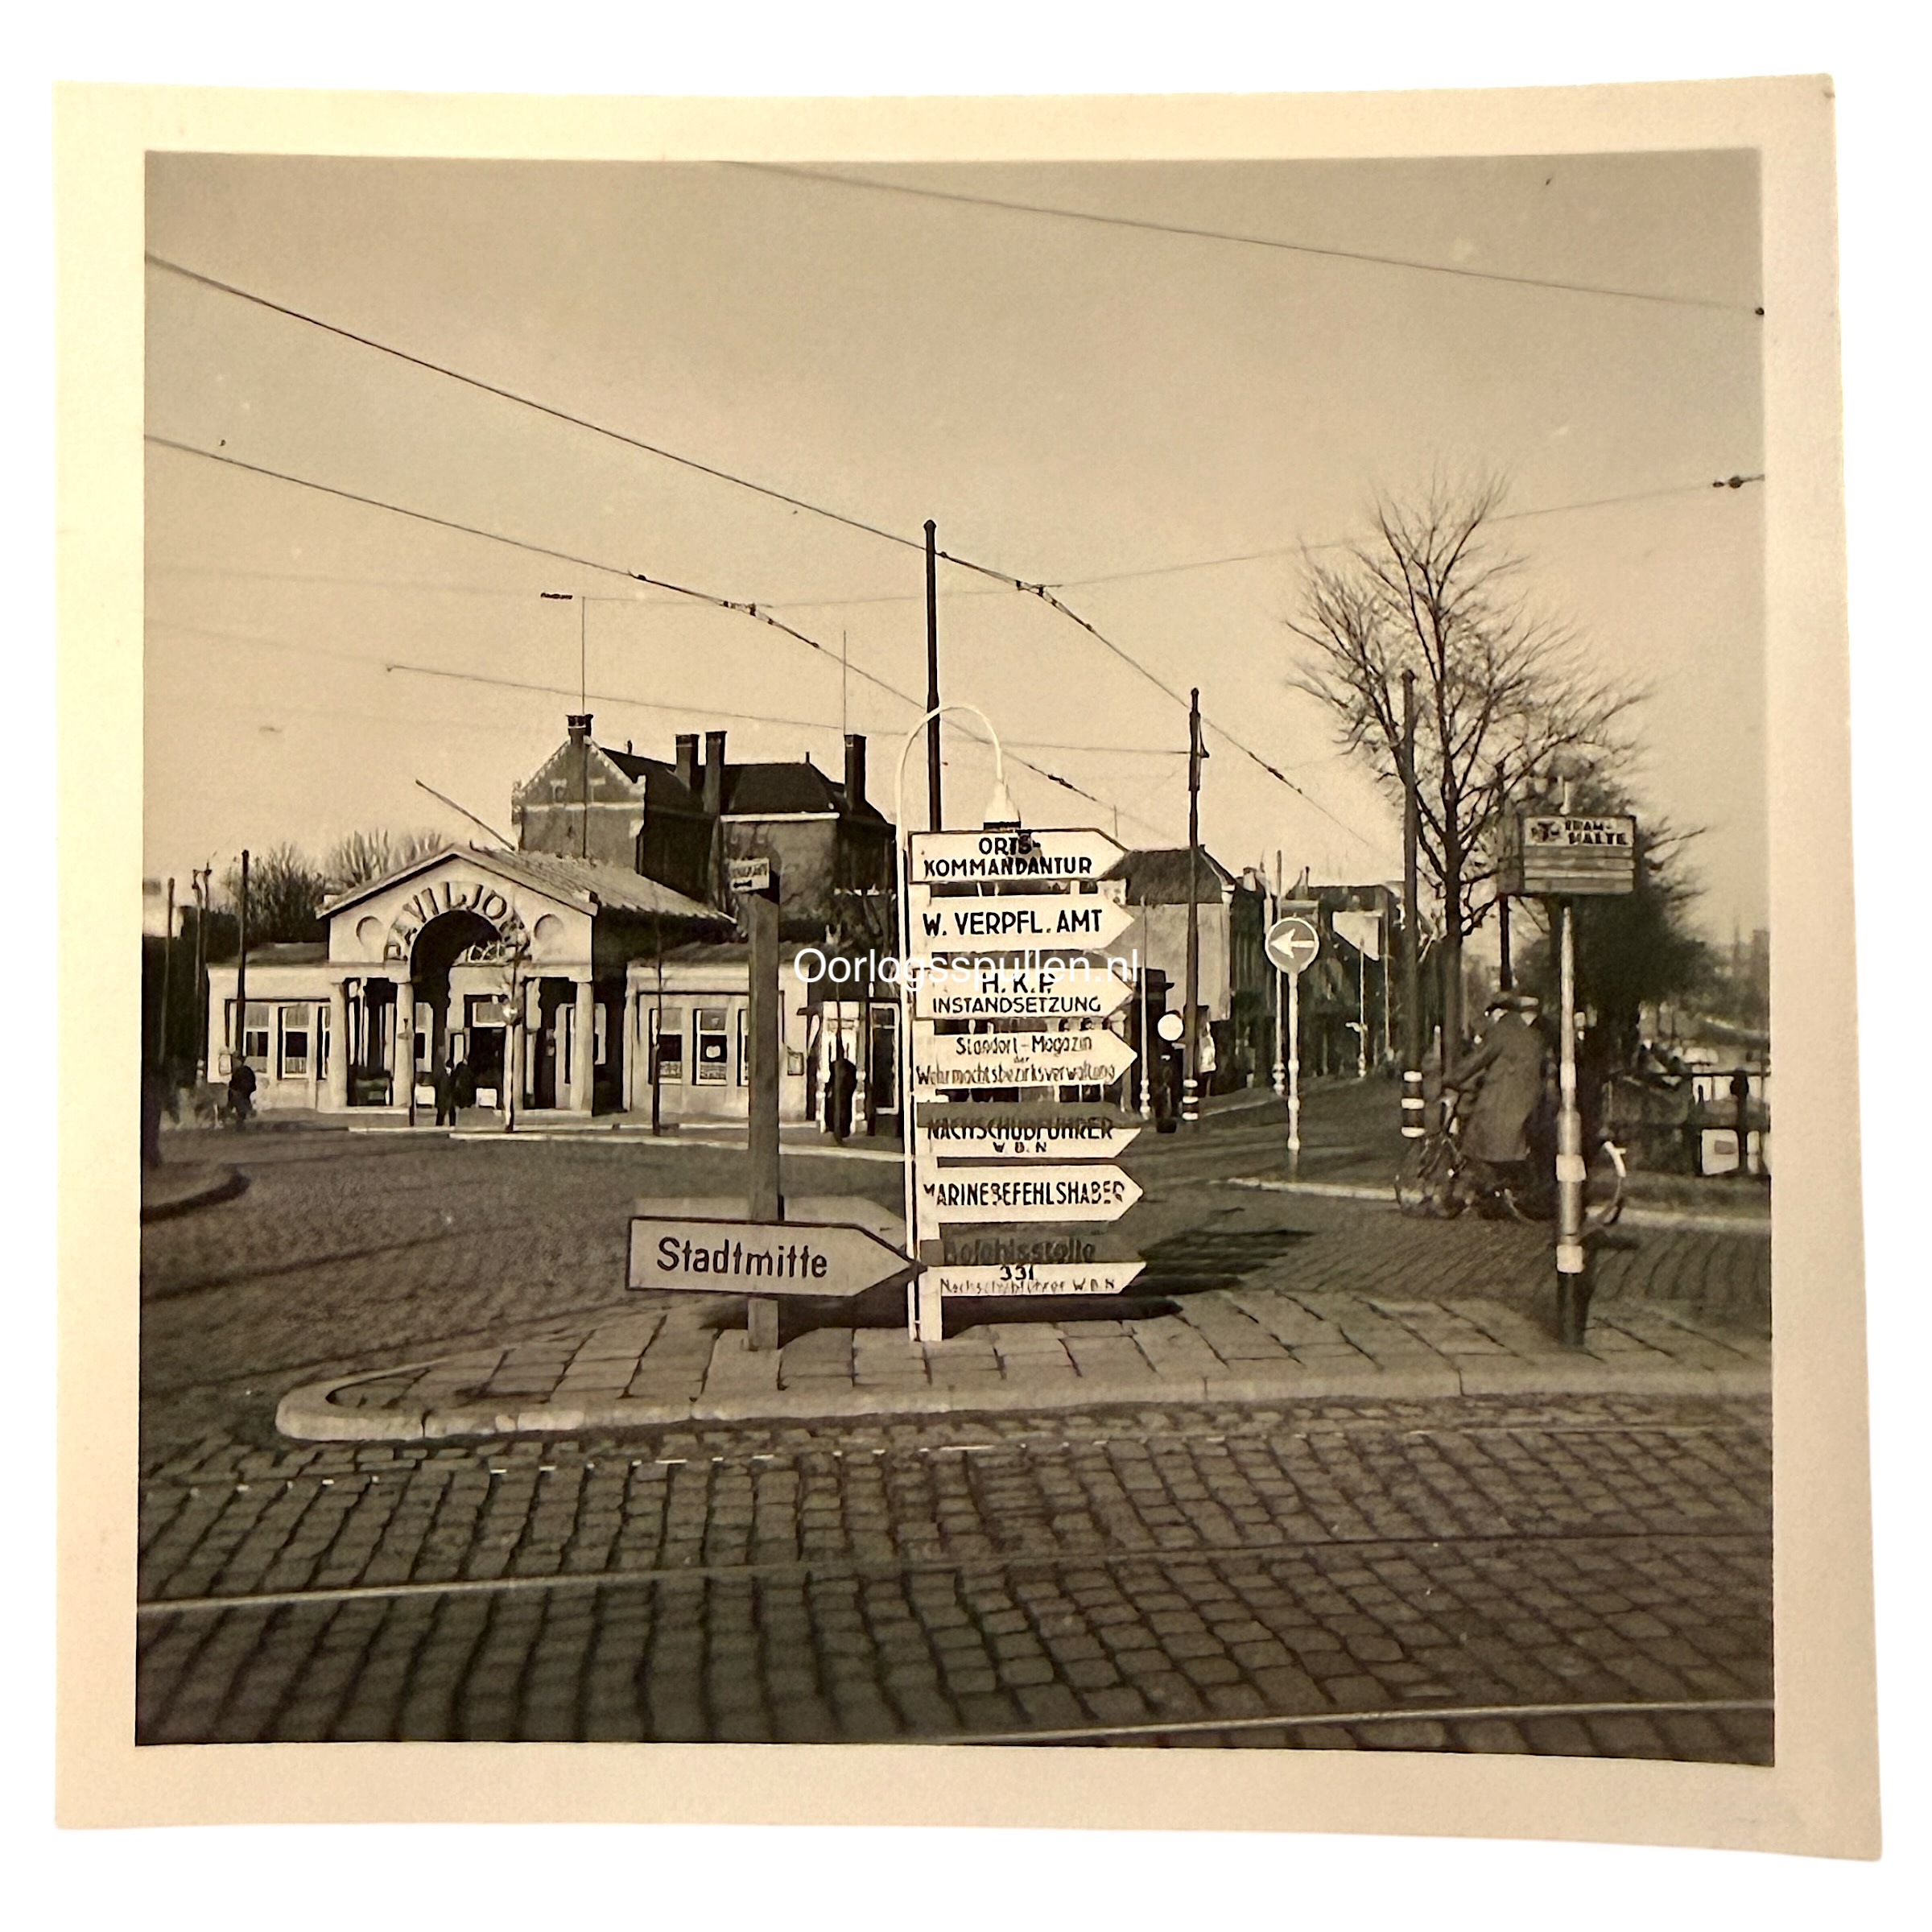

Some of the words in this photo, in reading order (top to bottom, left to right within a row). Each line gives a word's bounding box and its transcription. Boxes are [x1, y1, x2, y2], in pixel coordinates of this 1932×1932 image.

[924, 857, 1092, 877] KOMMANDANTUR
[1056, 909, 1103, 933] AMT
[932, 996, 1101, 1013] INSTANDSETZUNG
[657, 1236, 828, 1278] Stadtmitte
